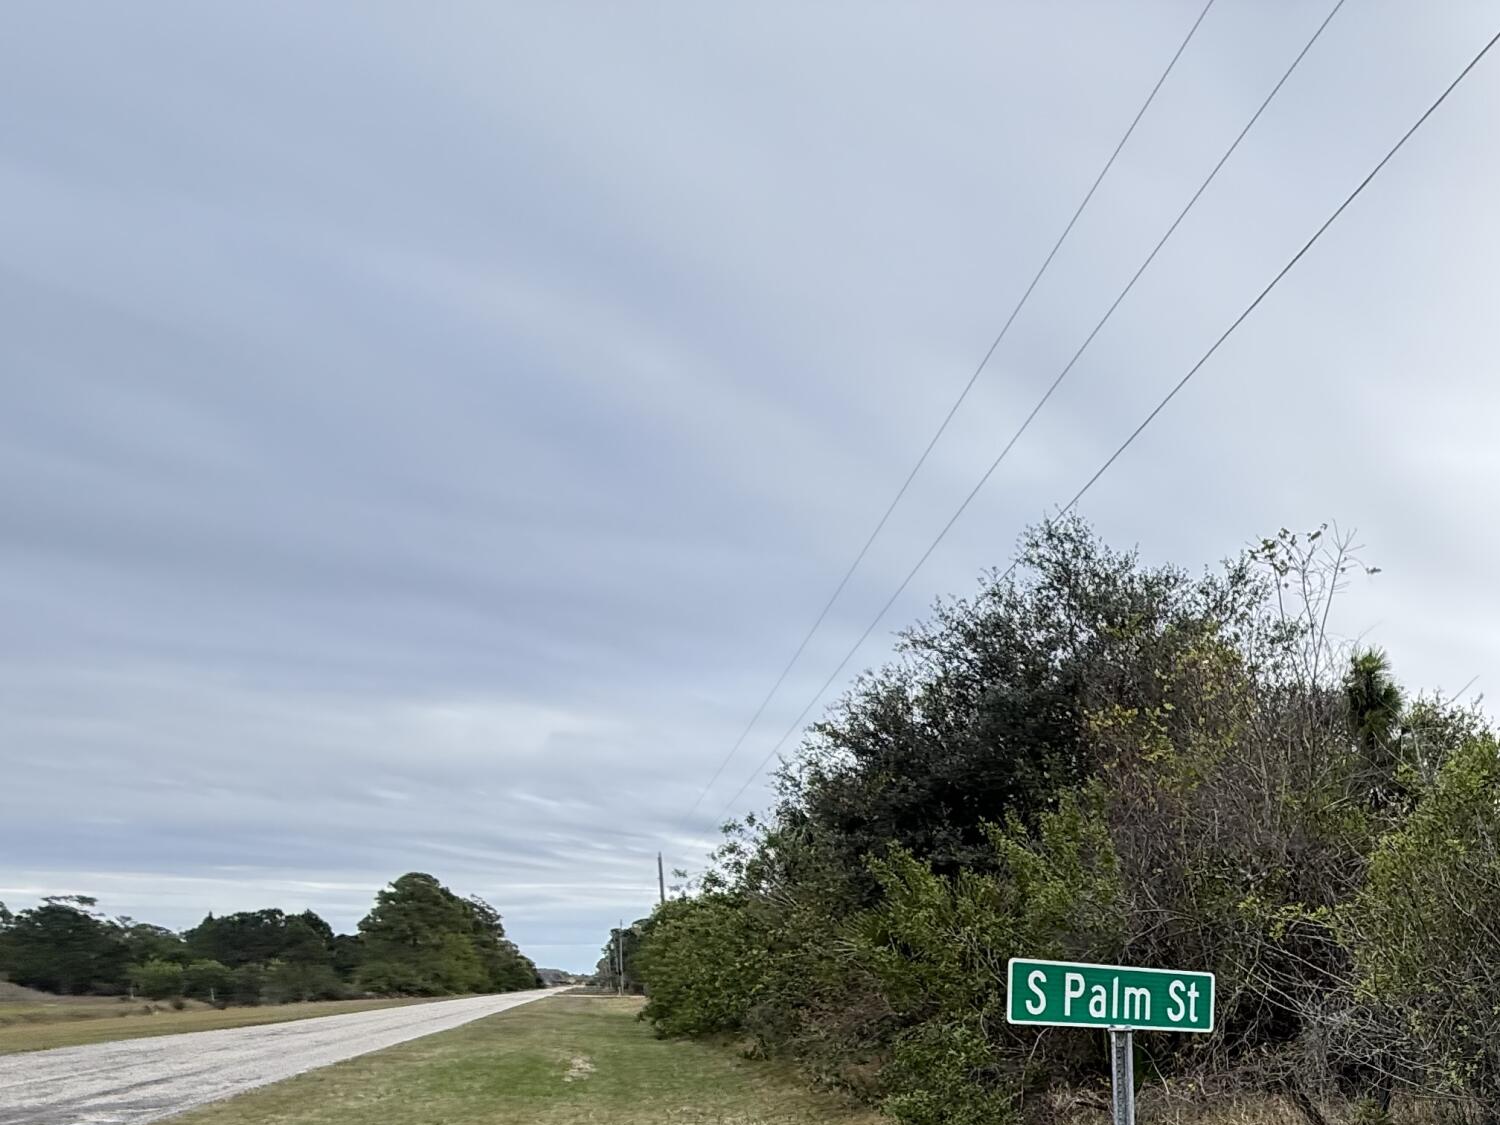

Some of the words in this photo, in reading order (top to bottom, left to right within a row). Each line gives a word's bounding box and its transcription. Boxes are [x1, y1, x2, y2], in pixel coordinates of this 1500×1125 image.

[1025, 970, 1047, 1015] S
[1064, 972, 1150, 1020] Palm
[1166, 979, 1200, 1023] St
